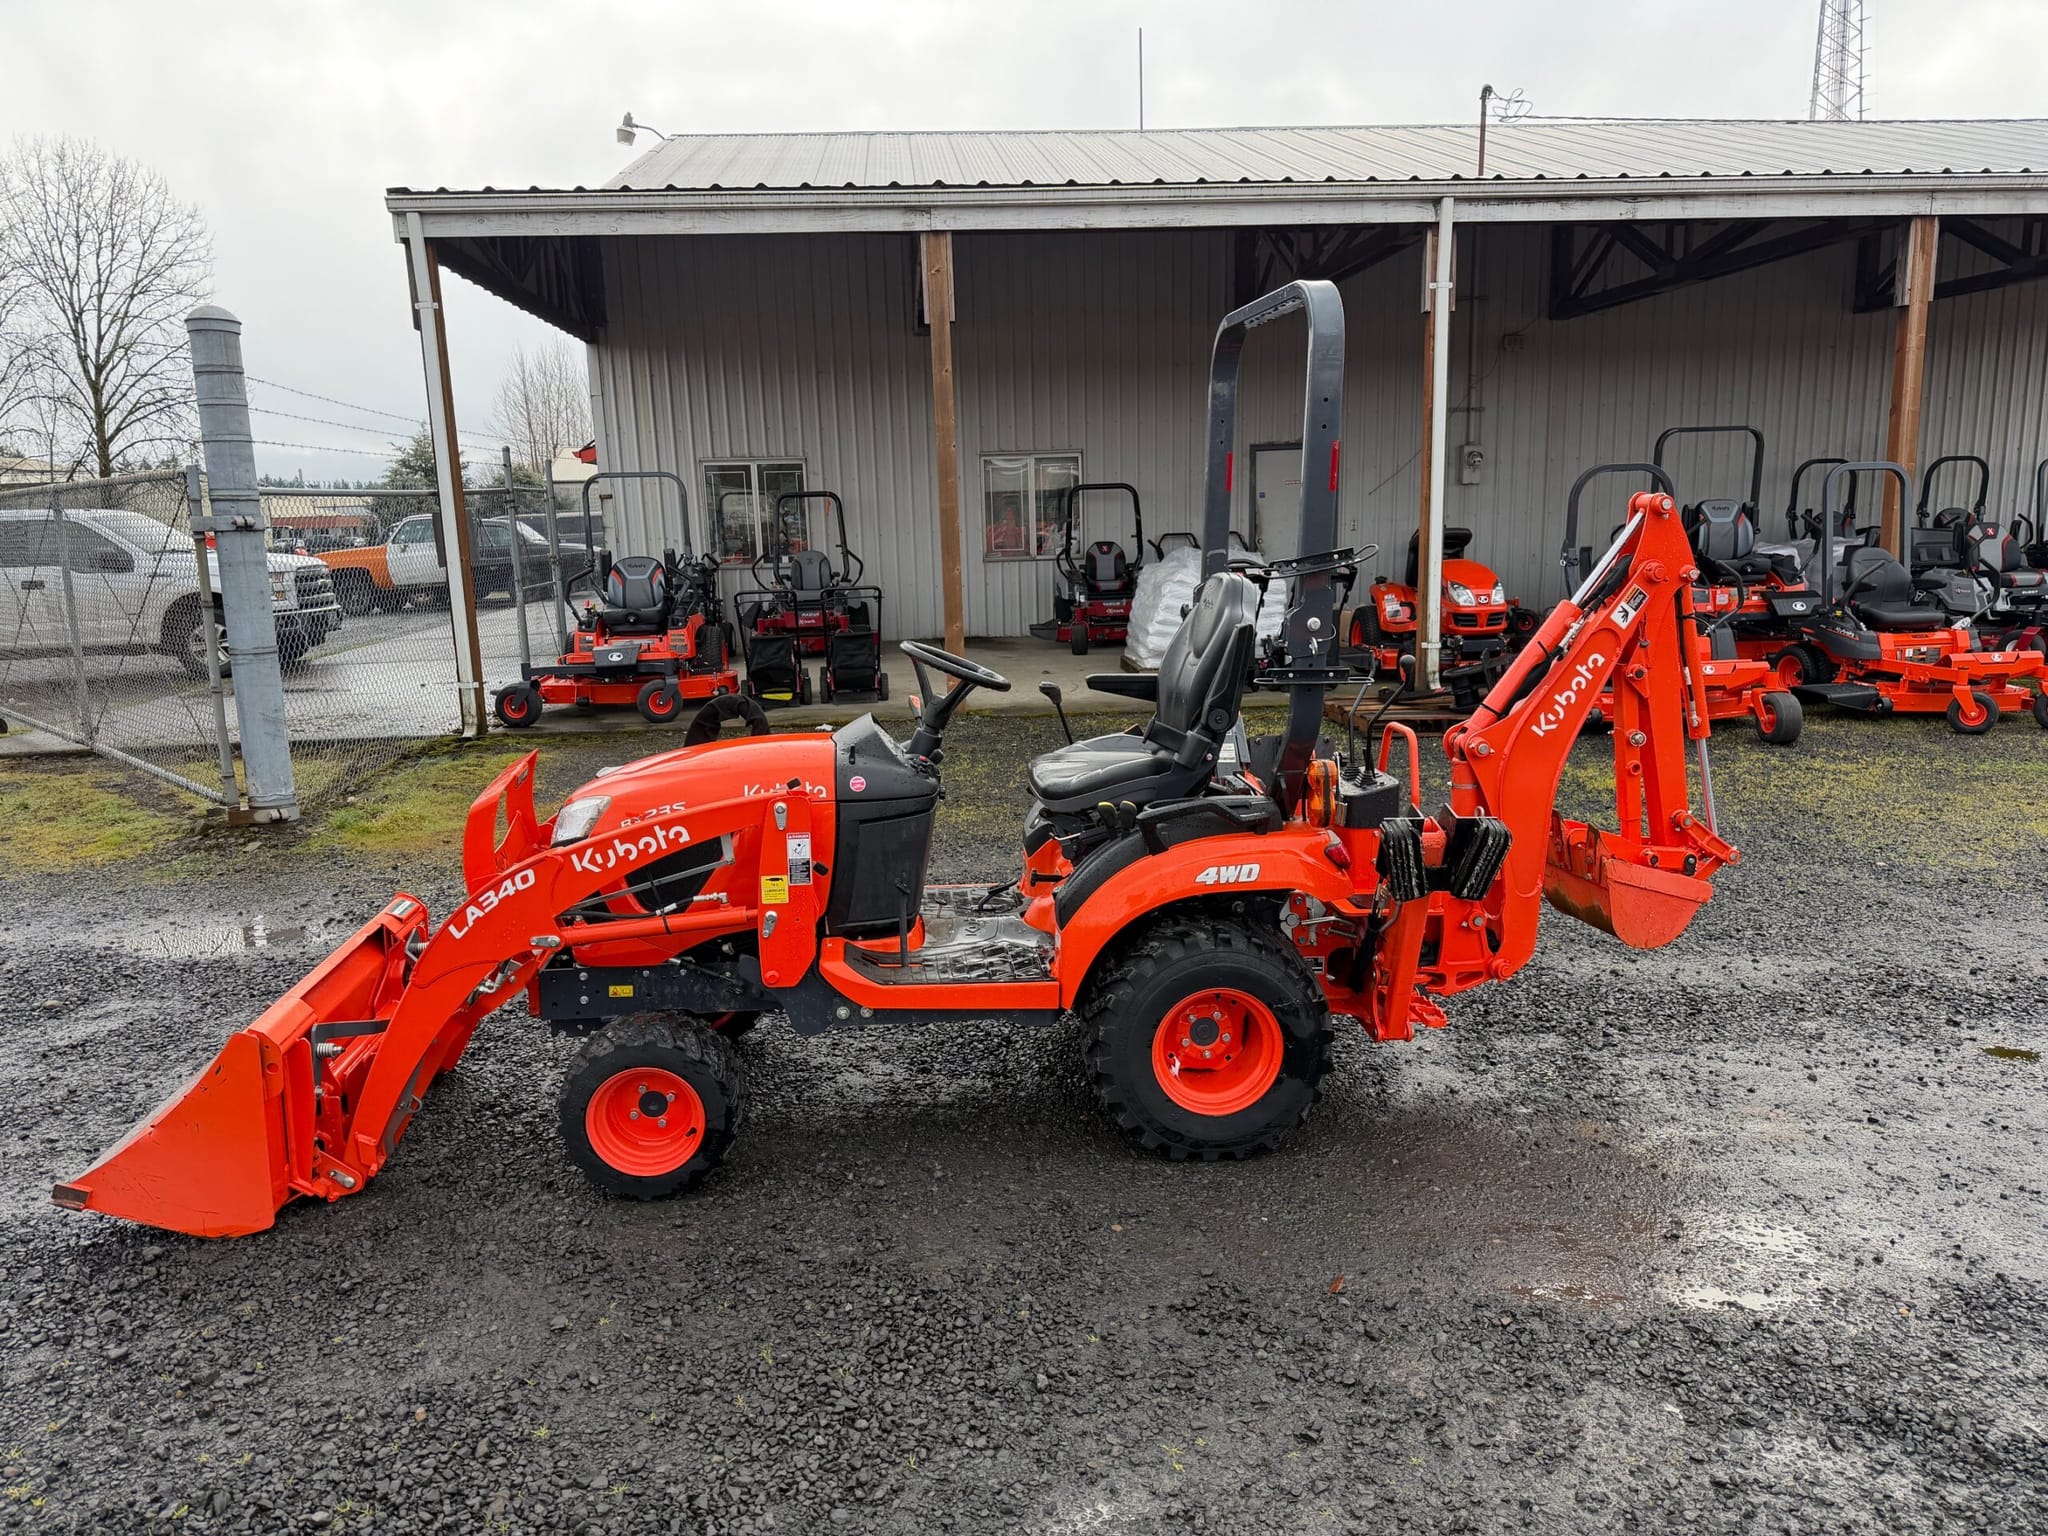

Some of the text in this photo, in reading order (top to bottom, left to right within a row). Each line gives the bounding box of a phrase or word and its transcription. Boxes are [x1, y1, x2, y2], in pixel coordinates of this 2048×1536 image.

[1530, 652, 1606, 737] Kubota
[571, 825, 691, 873] Kubota
[1195, 863, 1261, 885] 4WD
[448, 868, 536, 940] LA340
